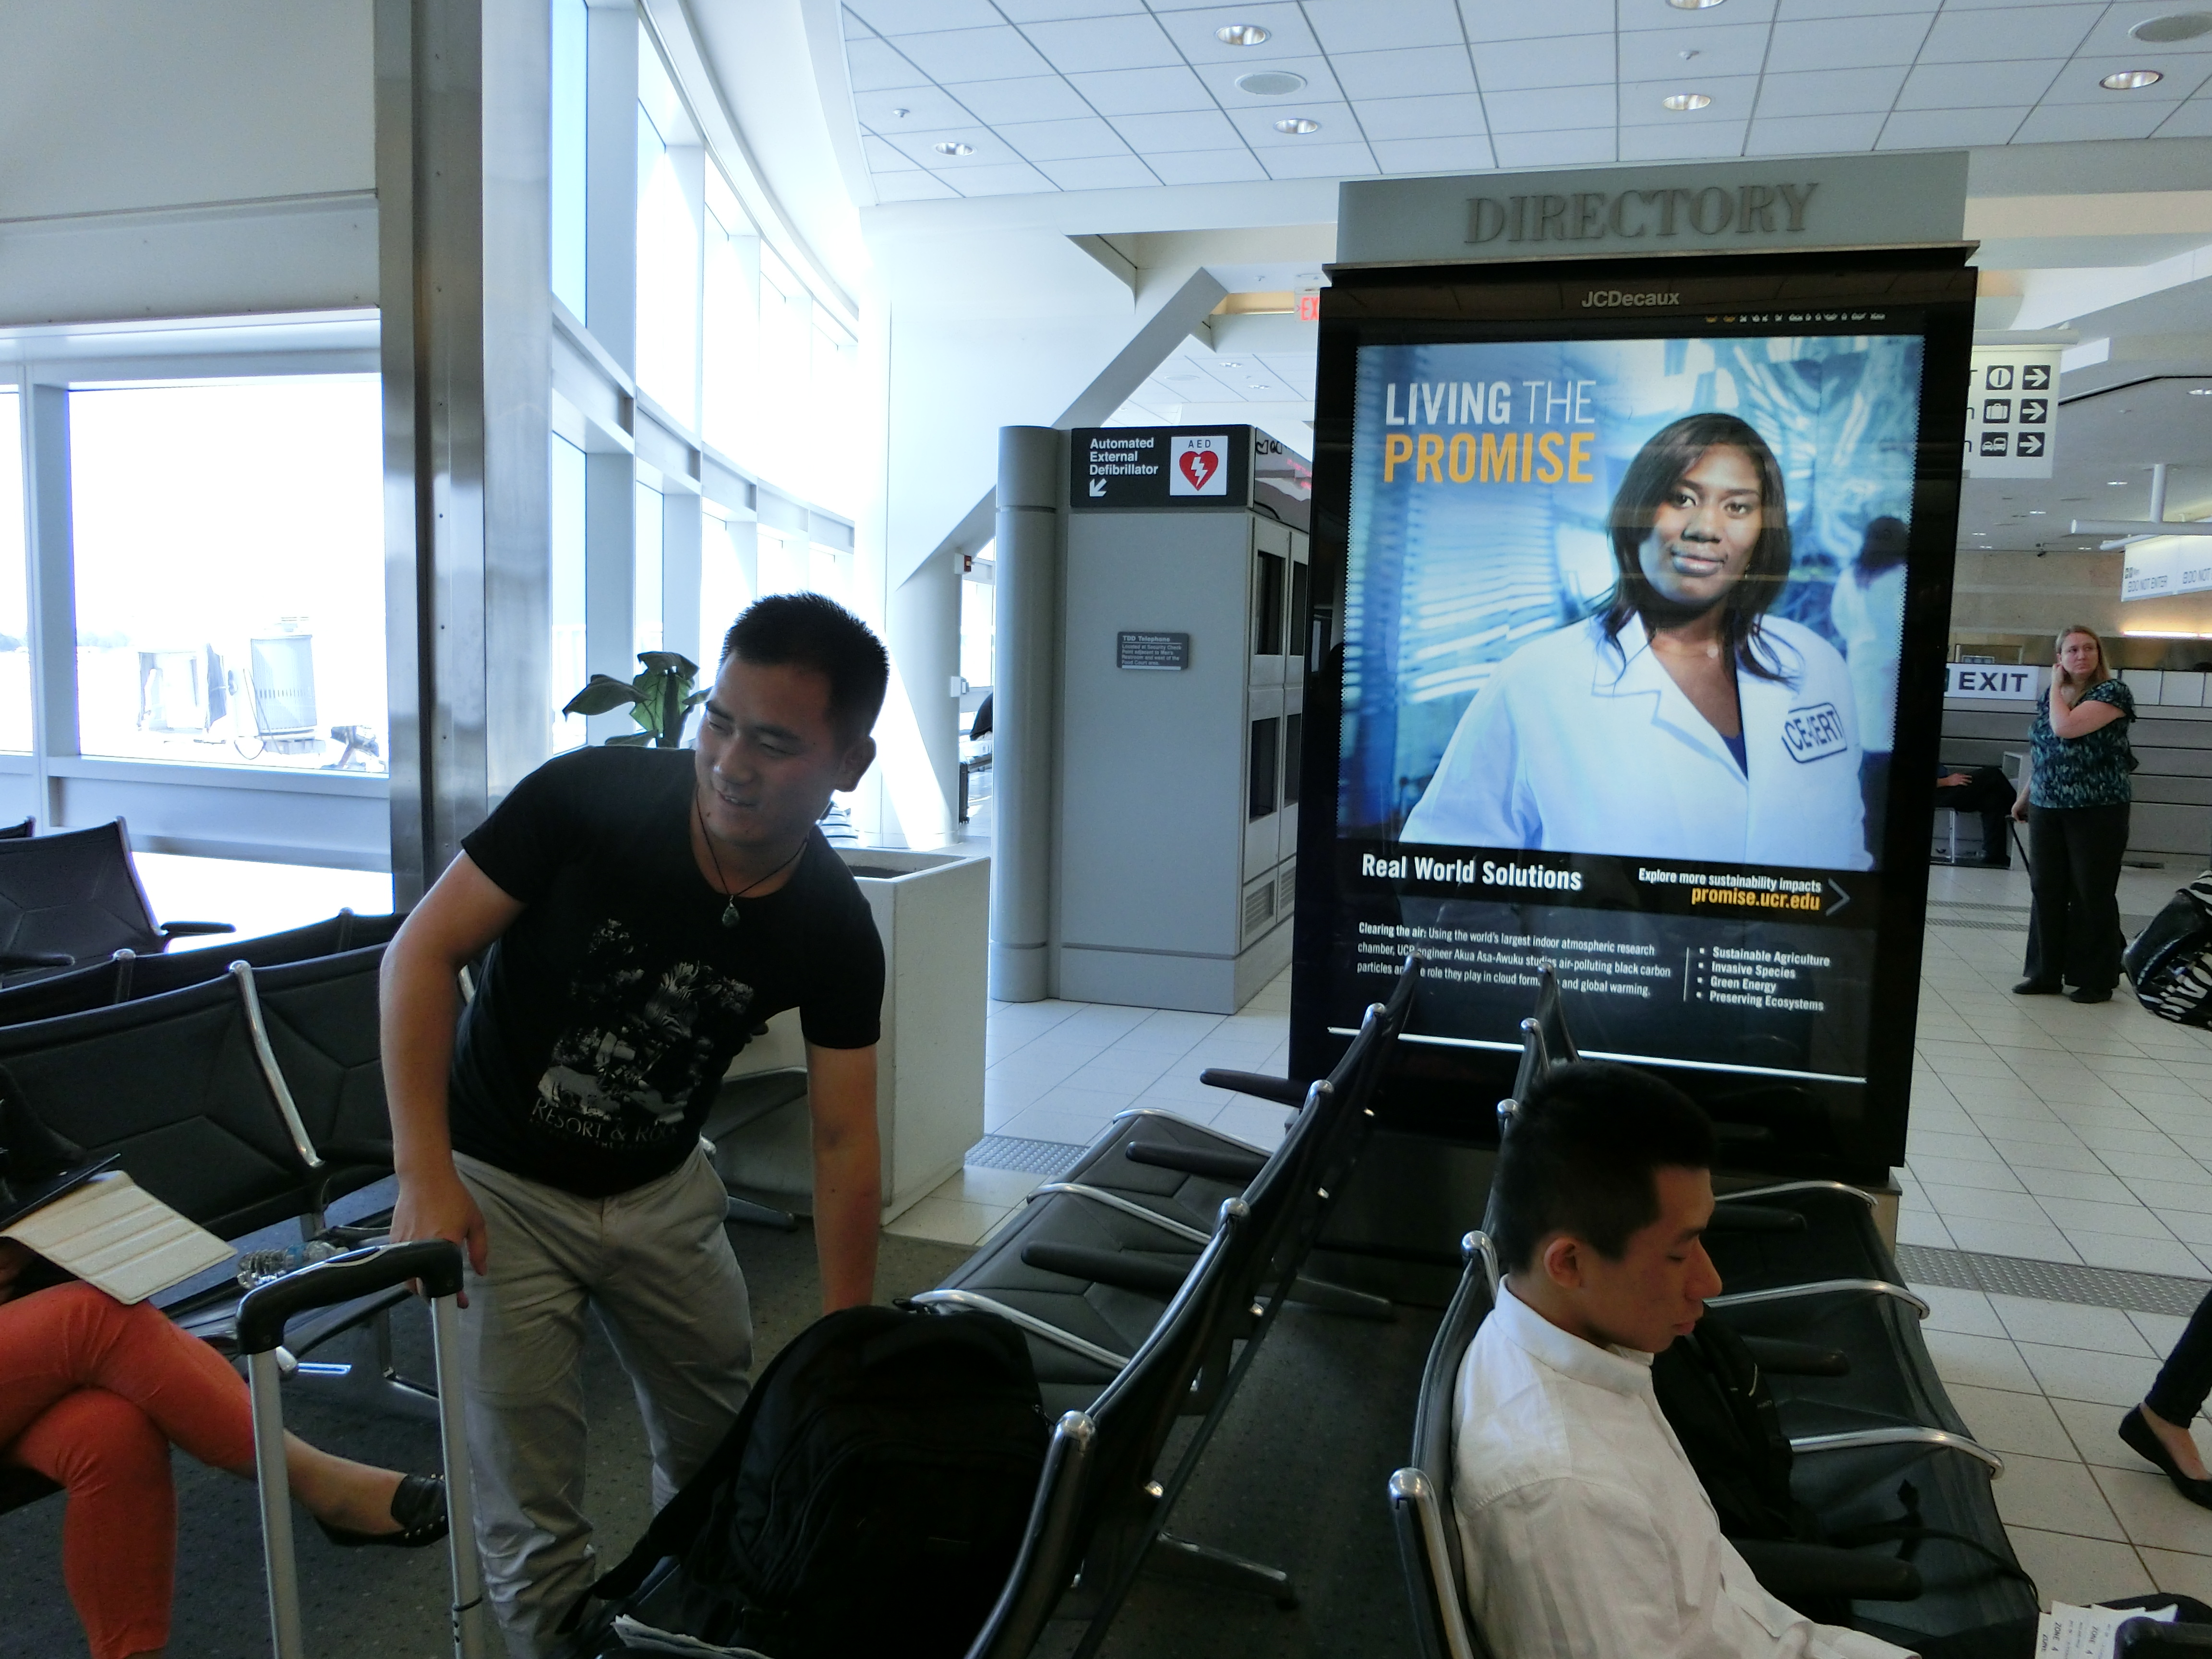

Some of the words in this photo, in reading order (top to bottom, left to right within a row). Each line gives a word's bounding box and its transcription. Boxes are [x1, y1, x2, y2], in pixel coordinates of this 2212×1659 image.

[1463, 182, 1819, 243] DIRECTORY
[1582, 291, 1679, 308] JCDecaux
[1385, 381, 1511, 425] LIVING
[1522, 380, 1596, 424] THE
[1090, 438, 1154, 449] Automated
[1188, 439, 1211, 448] AED
[1090, 451, 1138, 462] External
[1383, 433, 1595, 483] PROMISE
[1090, 464, 1158, 475] Defibrillator
[1959, 671, 2028, 692] EXIT
[1362, 854, 1407, 879] Real
[1414, 856, 1475, 883] World
[1482, 861, 1582, 891] Solutions
[1638, 867, 1677, 884] Explore
[1679, 873, 1706, 885] more
[1708, 874, 1778, 892] sustainability
[1779, 877, 1822, 893] impacts
[1692, 887, 1821, 911] promise.ucr.edu
[1359, 921, 1395, 938] Clearing
[1396, 925, 1410, 937] the
[1412, 926, 1426, 938] air:
[1429, 927, 1453, 942] Using
[1454, 929, 1468, 941] the
[1469, 931, 1499, 944] world's
[1501, 933, 1530, 948] largest
[1532, 935, 1560, 949] indoor
[1561, 938, 1615, 953] atmospheric
[1617, 944, 1655, 956] research
[1358, 941, 1395, 956] chamber,
[1454, 948, 1475, 961] Akua
[1476, 950, 1523, 965] Asa-Awuku
[1559, 957, 1612, 974] air-polluting
[1614, 961, 1638, 974] black
[1640, 964, 1671, 978] carbon
[1712, 946, 1772, 962] Sustainable
[1773, 951, 1830, 967] Agriculture
[1357, 961, 1392, 974] particles
[1427, 966, 1442, 978] role
[1444, 967, 1462, 982] they
[1464, 969, 1481, 983] play
[1483, 970, 1491, 981] in
[1493, 972, 1516, 984] cloud
[1562, 978, 1578, 990] and
[1580, 979, 1608, 993] global
[1610, 983, 1651, 998] warming.
[1712, 960, 1752, 975] Invasive
[1755, 963, 1796, 979] Species
[1710, 975, 1740, 989] Green
[1742, 977, 1777, 994] Energy
[1709, 990, 1763, 1008] Preserving
[1765, 995, 1825, 1012] Ecosystems
[531, 1097, 604, 1139] RESORT
